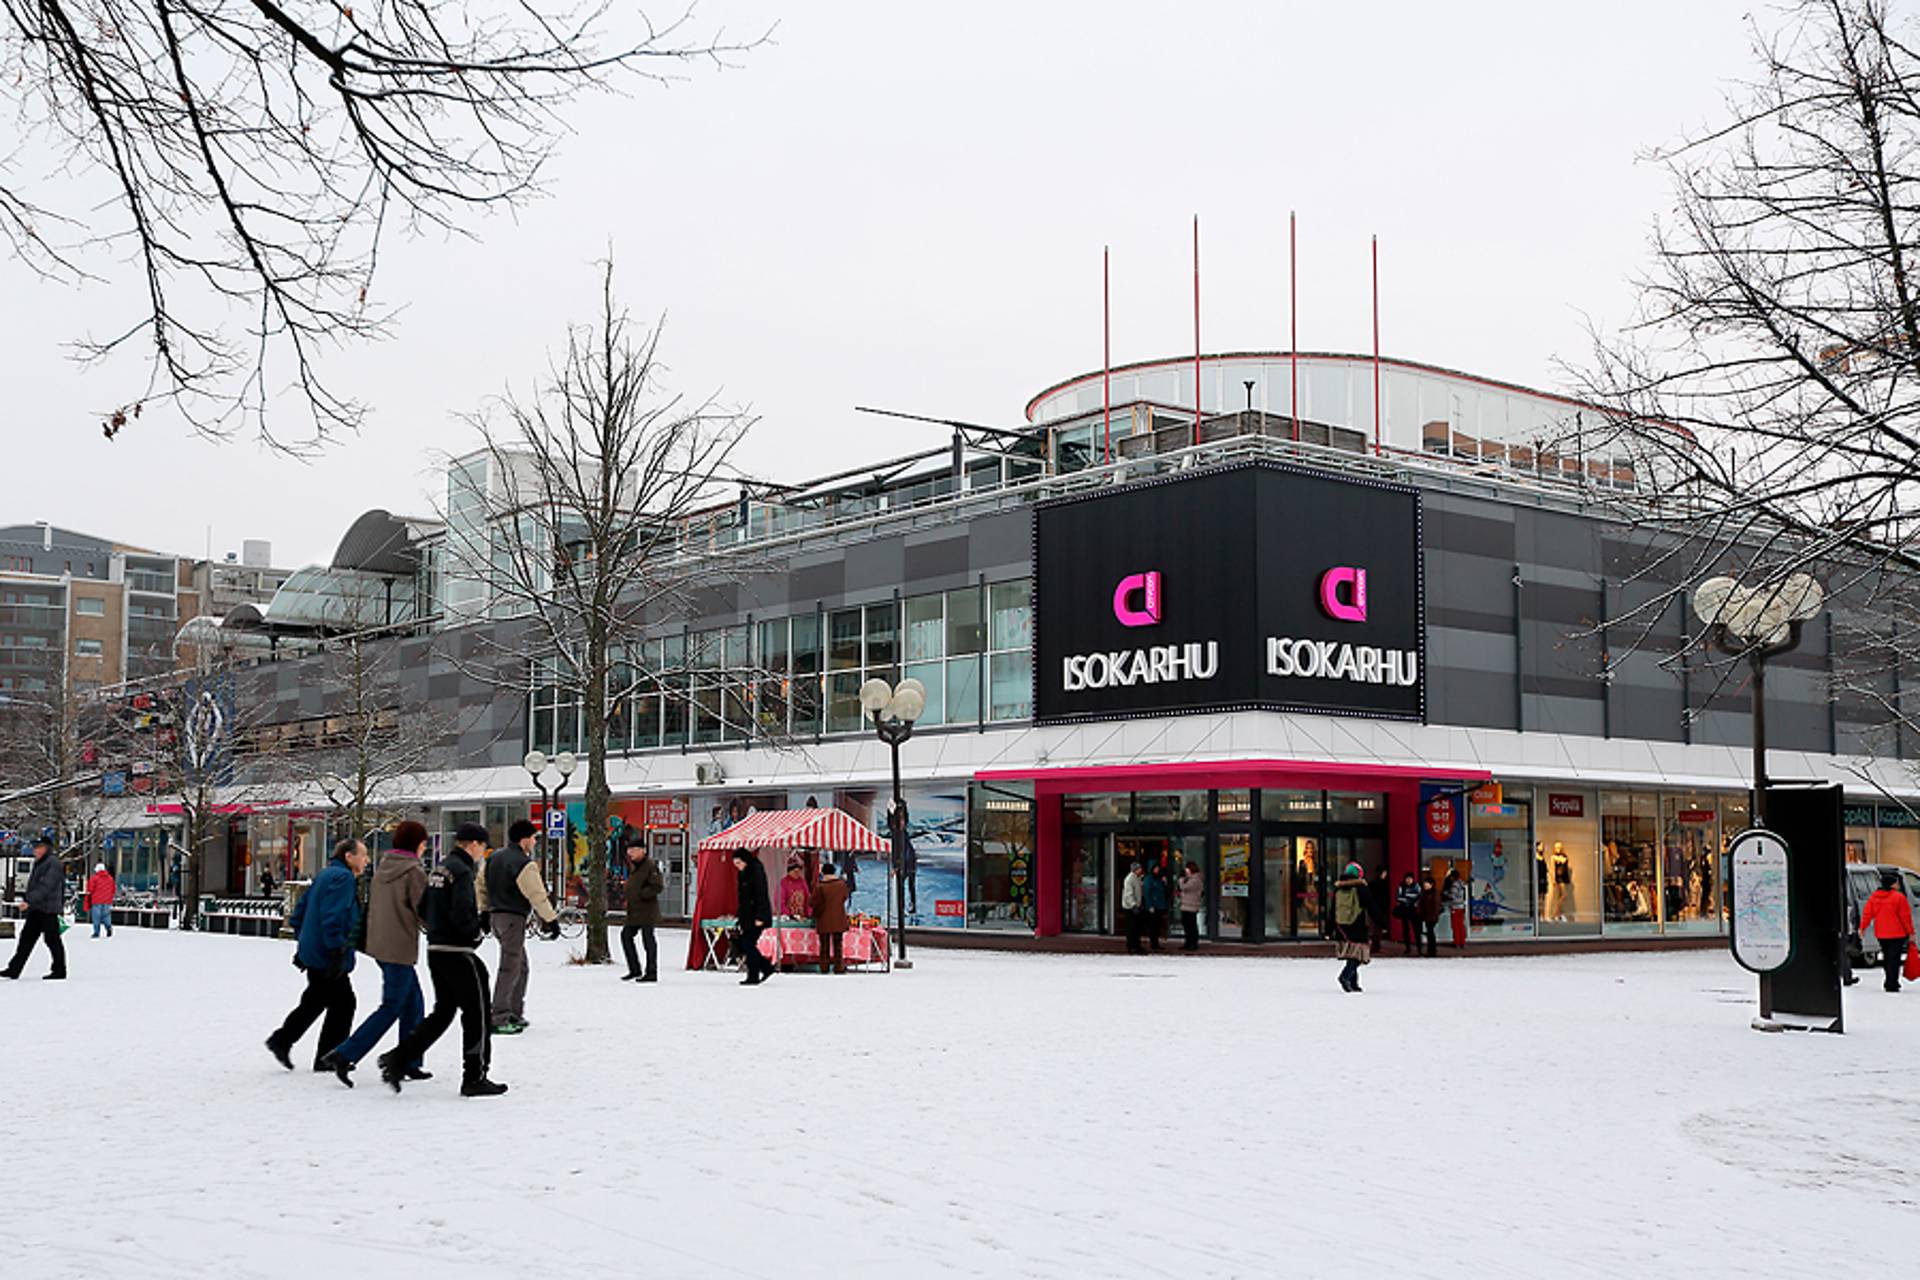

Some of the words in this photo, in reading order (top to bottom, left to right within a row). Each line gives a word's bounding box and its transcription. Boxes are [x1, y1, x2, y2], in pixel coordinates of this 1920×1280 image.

[1063, 640, 1218, 691] ISOKARHU
[1266, 637, 1417, 686] ISOKARHU
[550, 812, 562, 827] P
